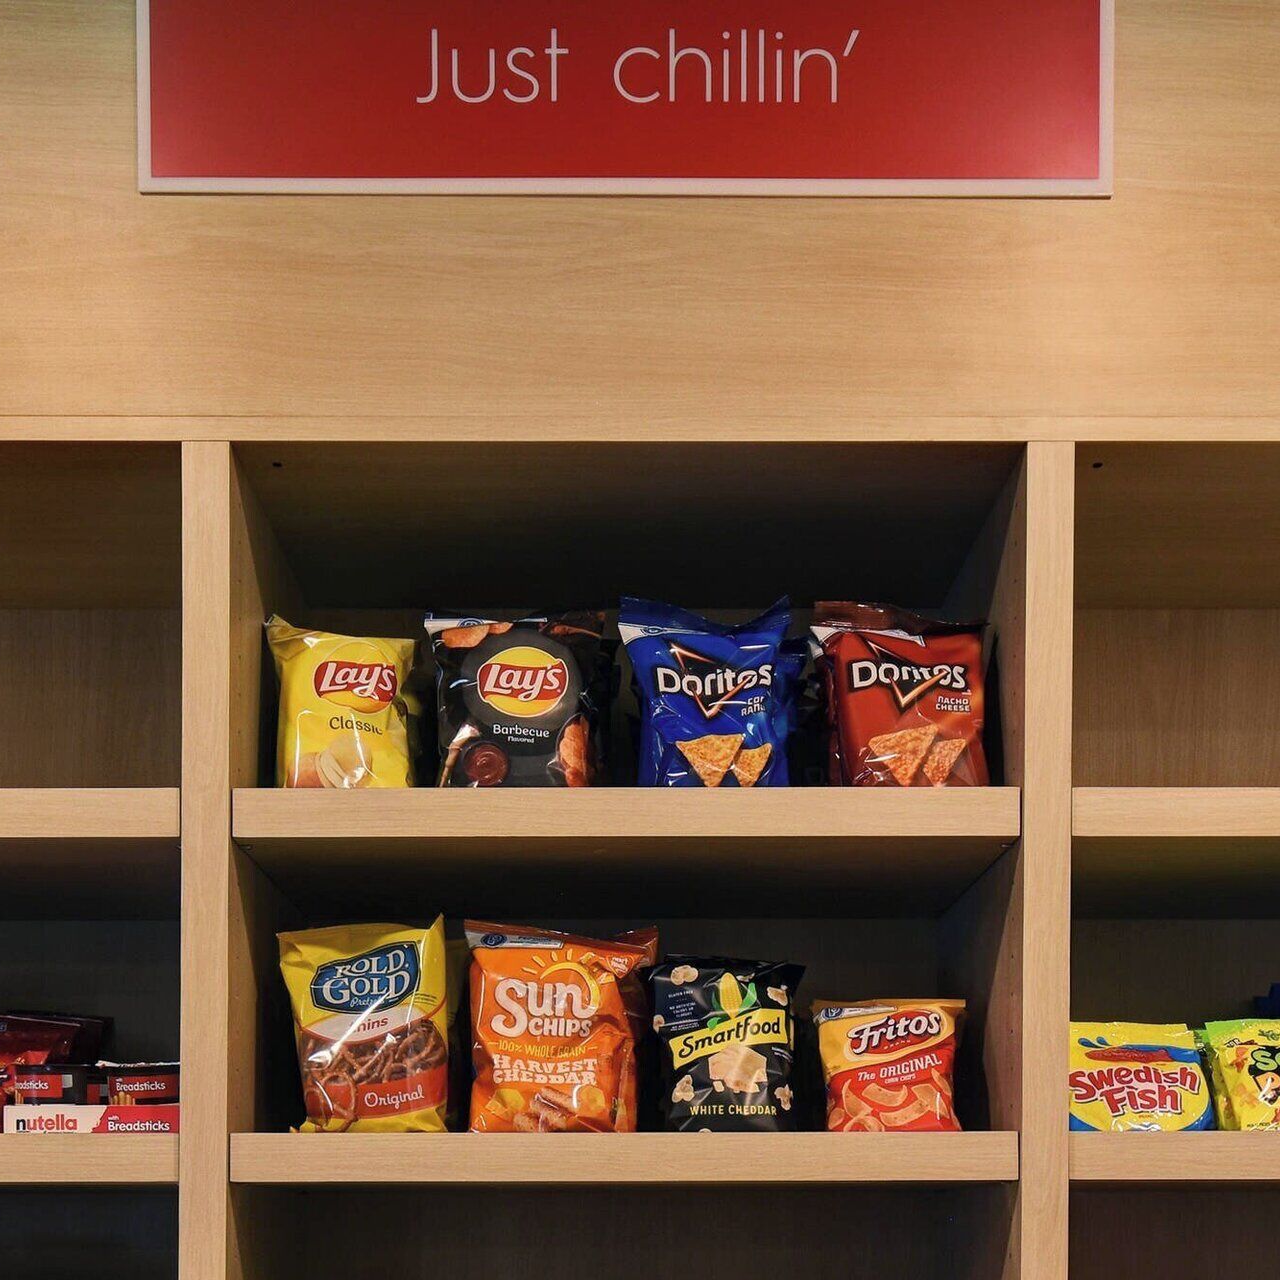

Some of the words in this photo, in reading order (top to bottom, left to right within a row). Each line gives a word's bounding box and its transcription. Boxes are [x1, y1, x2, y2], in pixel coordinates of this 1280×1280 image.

[417, 28, 568, 103] Just
[320, 661, 397, 700] Lay's
[483, 663, 561, 701] Lay's
[656, 664, 773, 698] Doritos
[935, 703, 971, 712] CHEESE
[937, 696, 969, 705] NACHO
[493, 724, 550, 738] Barbecue
[334, 950, 407, 979] ROLD
[322, 970, 410, 1004] GOLD
[490, 977, 600, 1038] Sun
[528, 1017, 593, 1037] CHIPS
[678, 1016, 781, 1058] Smartfood
[847, 1012, 942, 1054] Fritos
[492, 1054, 598, 1073] HARVEST
[524, 1045, 556, 1058] WHOLE
[493, 1068, 598, 1085] CHEDDAR
[857, 1071, 877, 1081] The
[880, 1054, 943, 1078] ORIGINAL
[115, 1081, 166, 1092] Breadsticks
[1069, 1065, 1199, 1101] Swedish
[365, 1085, 425, 1108] Original
[1100, 1084, 1180, 1114] Fish
[15, 1113, 78, 1131] nutella
[689, 1104, 725, 1116] WHITE
[728, 1103, 778, 1116] CHEDDAR
[107, 1120, 170, 1132] Breadsticks
